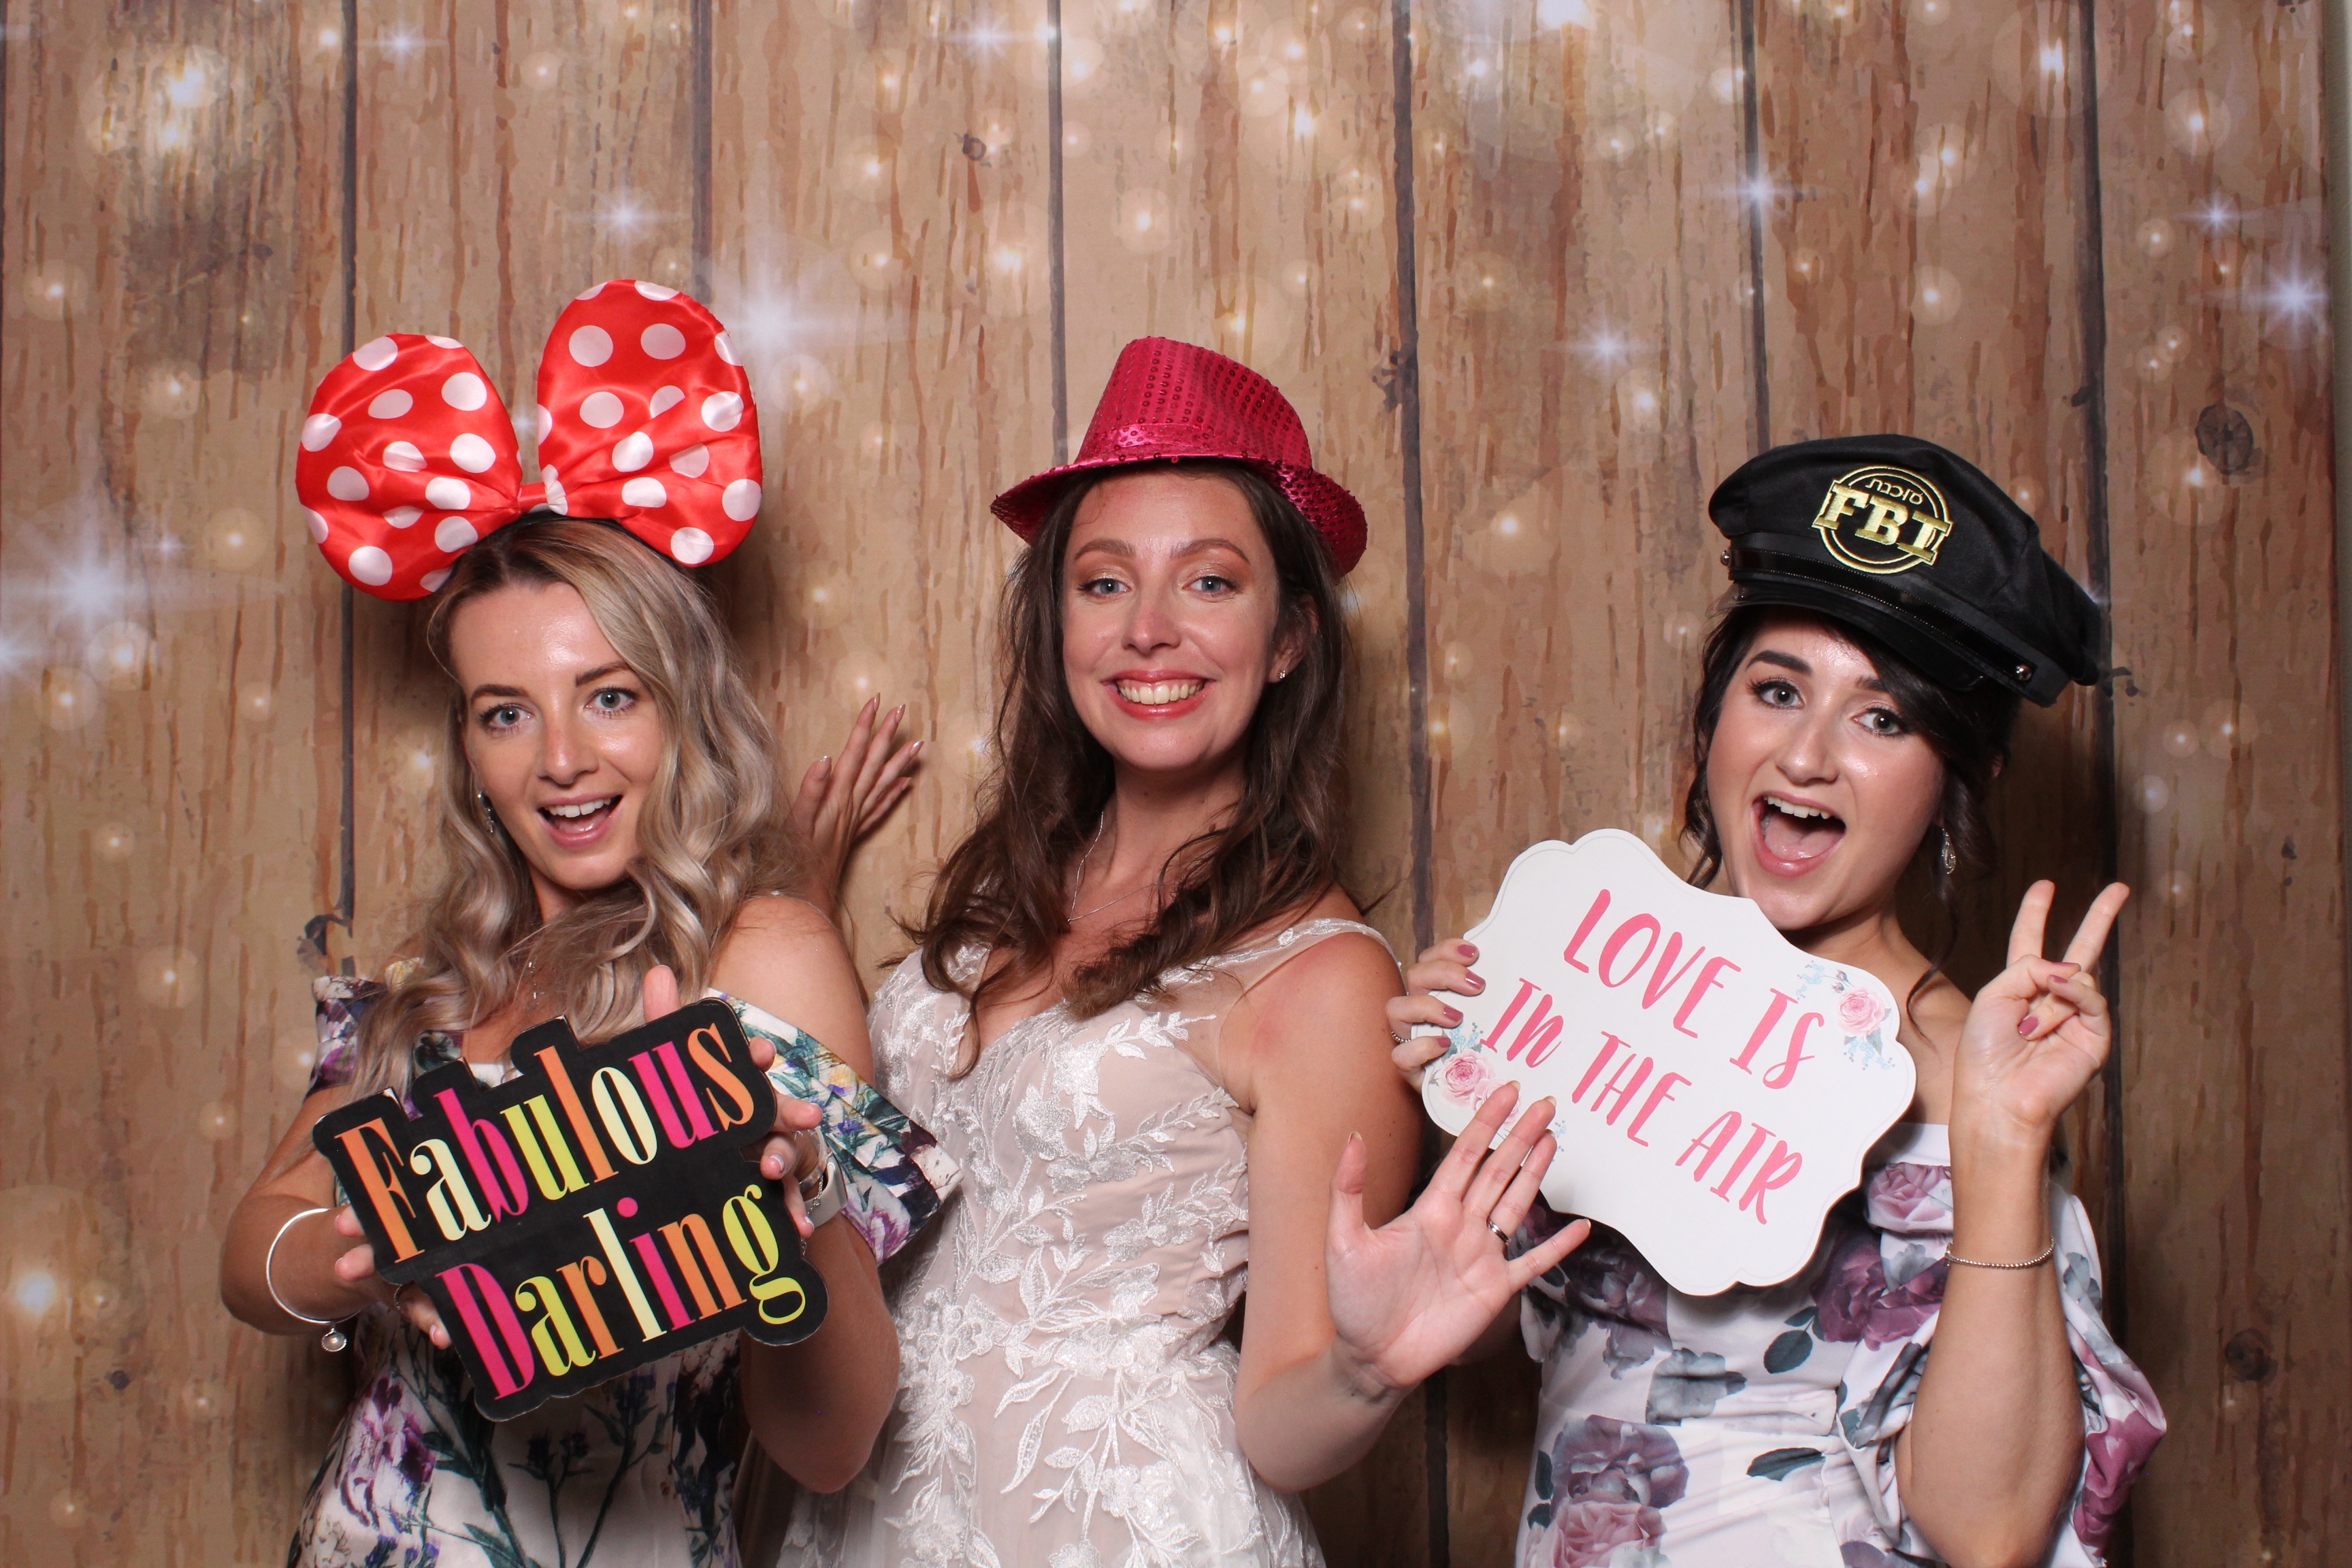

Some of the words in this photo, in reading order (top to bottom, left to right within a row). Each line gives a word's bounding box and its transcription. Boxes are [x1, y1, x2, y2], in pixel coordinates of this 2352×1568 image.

[1814, 483, 1950, 561] FBI
[1563, 888, 1742, 1039] LOVE
[1729, 987, 1825, 1089] IS
[334, 1022, 755, 1264] Fabulous
[1571, 1030, 1692, 1147] THE
[1674, 1111, 1803, 1225] AIR
[435, 1184, 806, 1401] Darling
